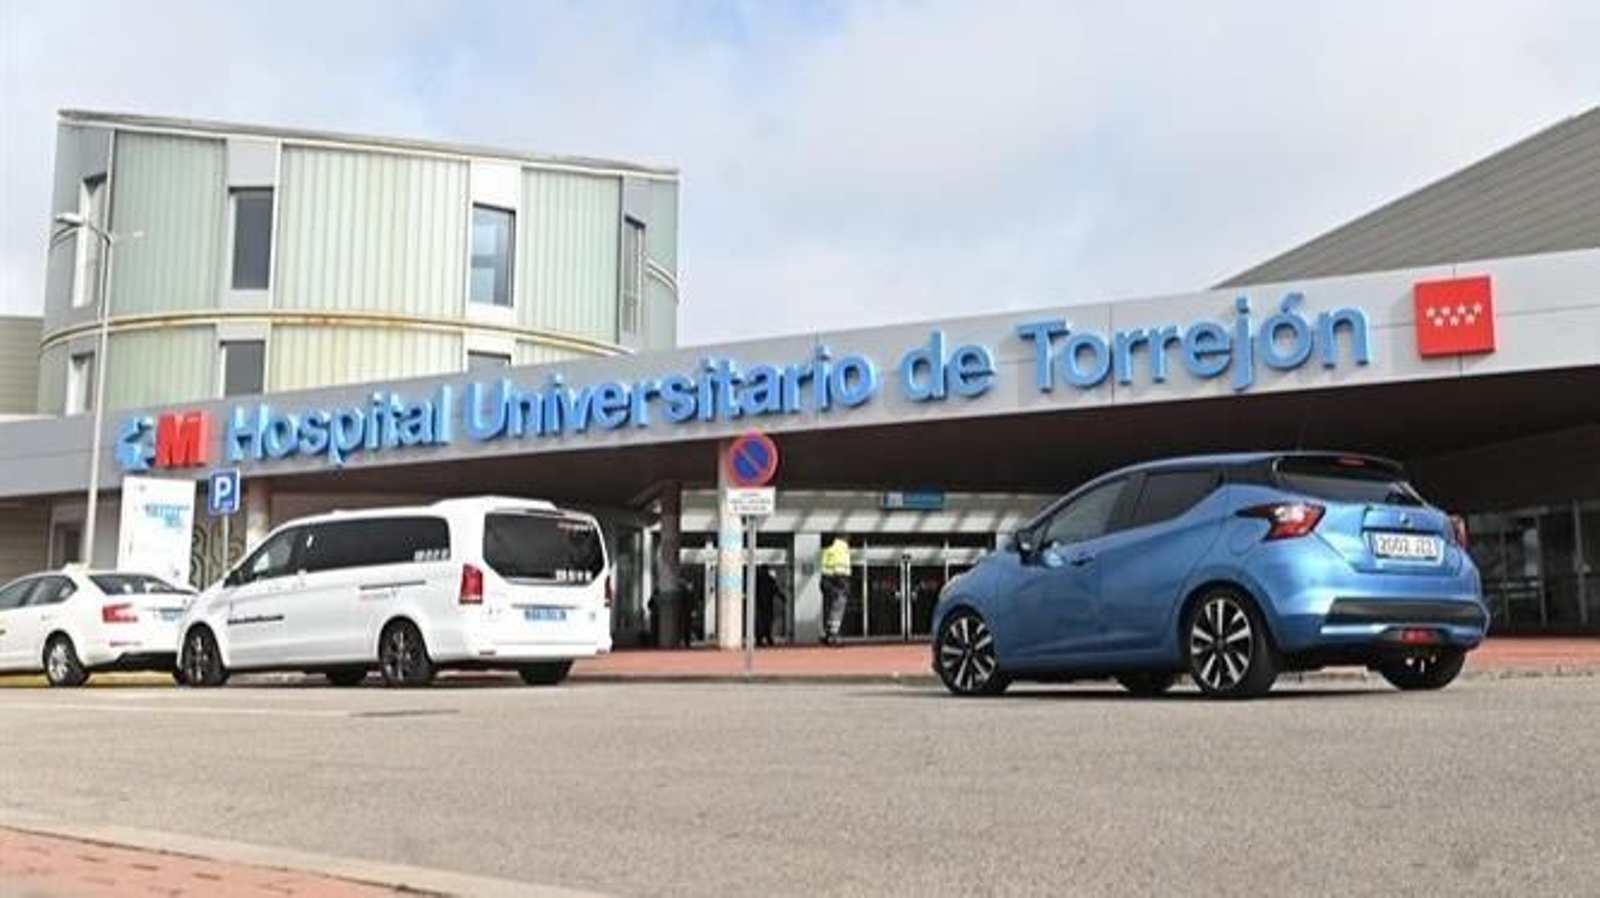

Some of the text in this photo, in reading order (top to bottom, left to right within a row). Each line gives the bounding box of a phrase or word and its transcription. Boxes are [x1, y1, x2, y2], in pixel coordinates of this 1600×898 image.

[228, 385, 451, 467] Hospital
[466, 345, 876, 441] Universitario
[902, 329, 995, 402] de
[1017, 292, 1369, 392] Torrejón
[214, 475, 232, 509] P
